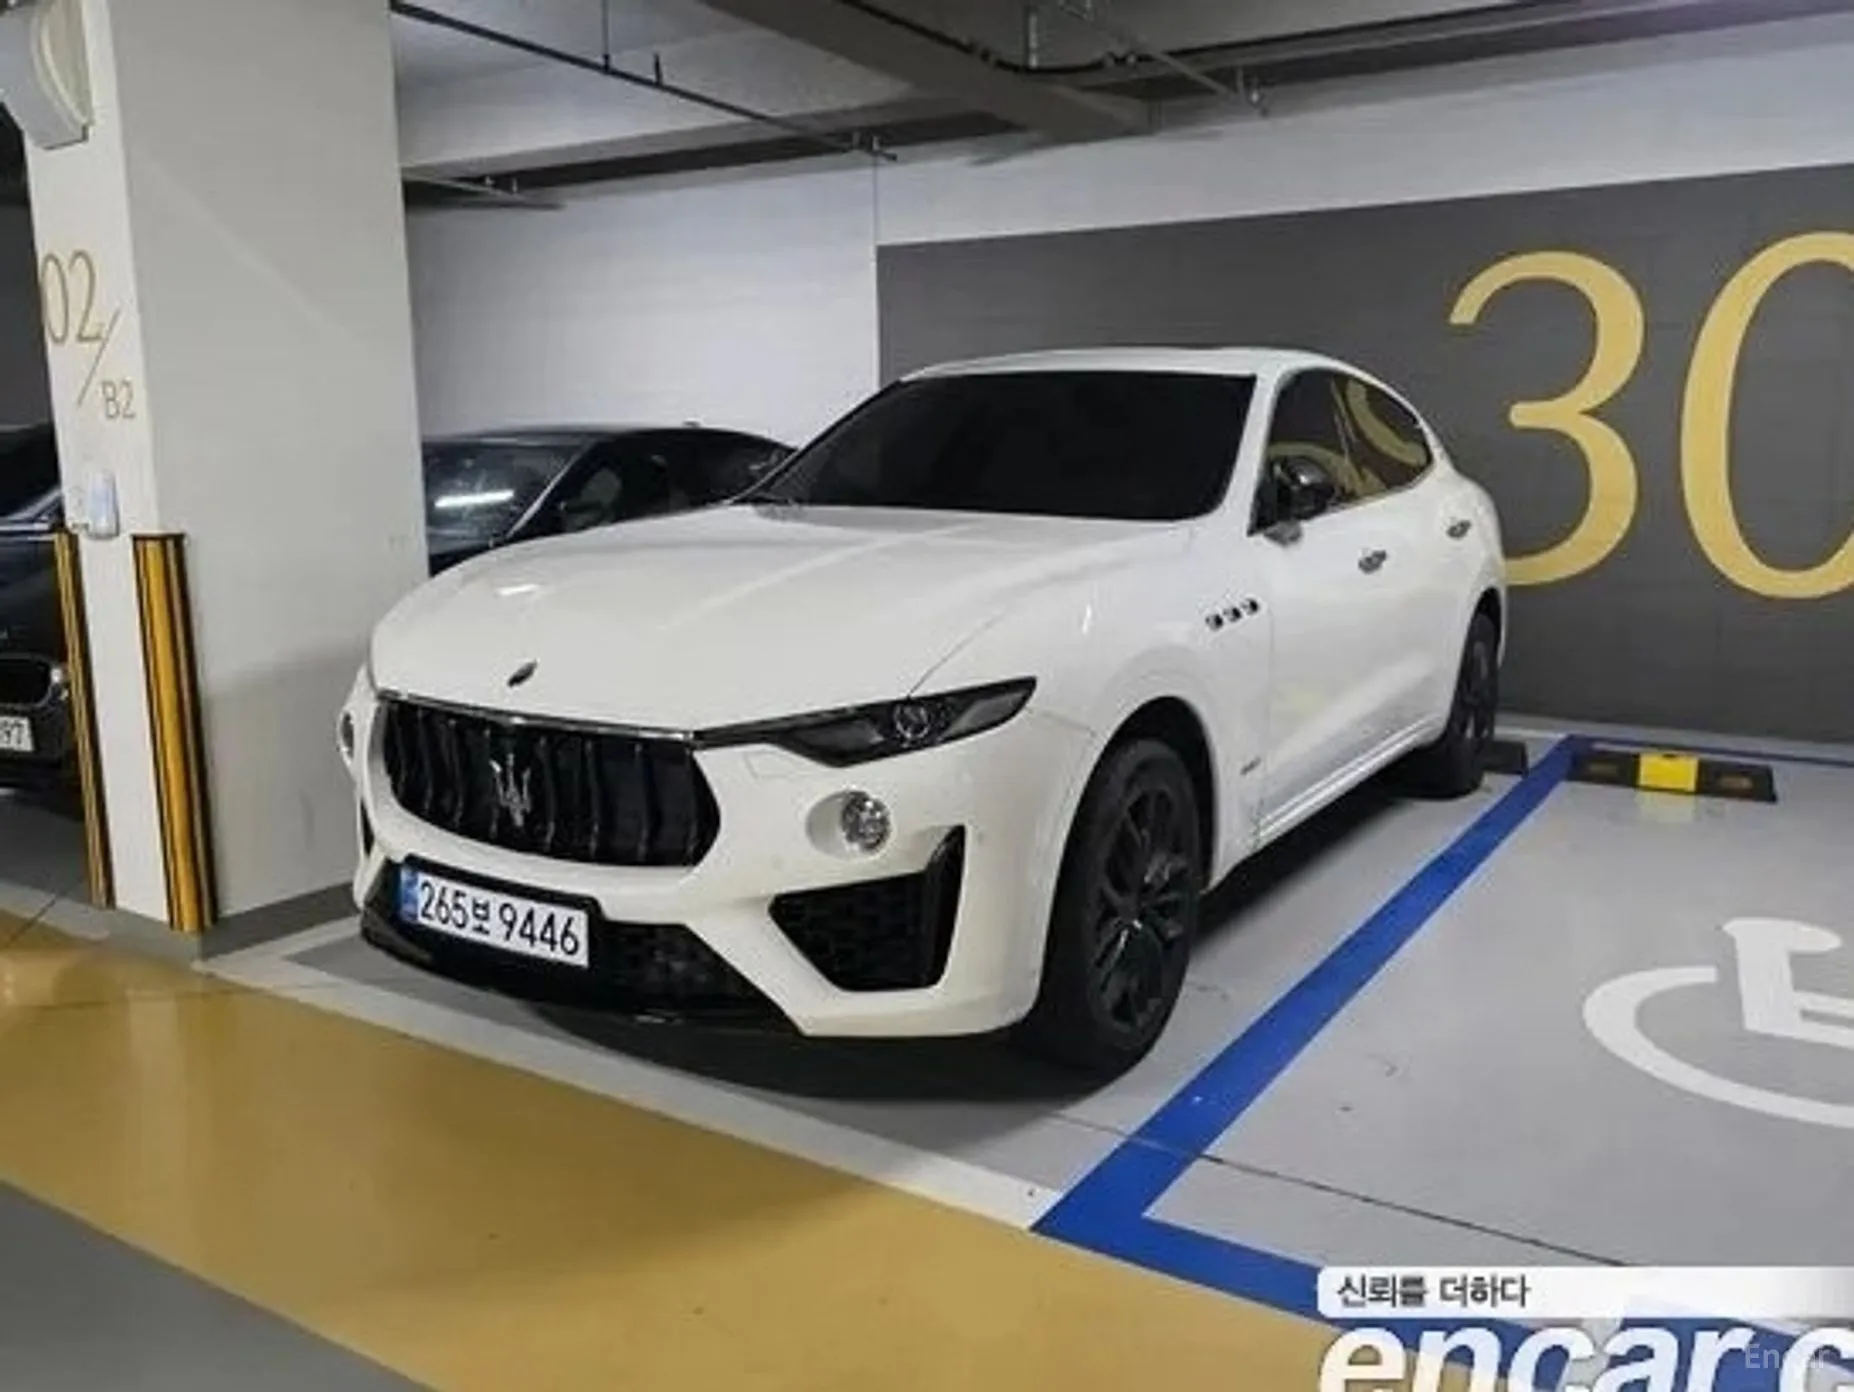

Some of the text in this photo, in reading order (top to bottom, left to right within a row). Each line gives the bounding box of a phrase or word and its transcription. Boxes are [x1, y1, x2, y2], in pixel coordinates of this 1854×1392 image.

[102, 379, 136, 420] B2
[1449, 231, 1854, 599] 30
[499, 902, 580, 957] 9446
